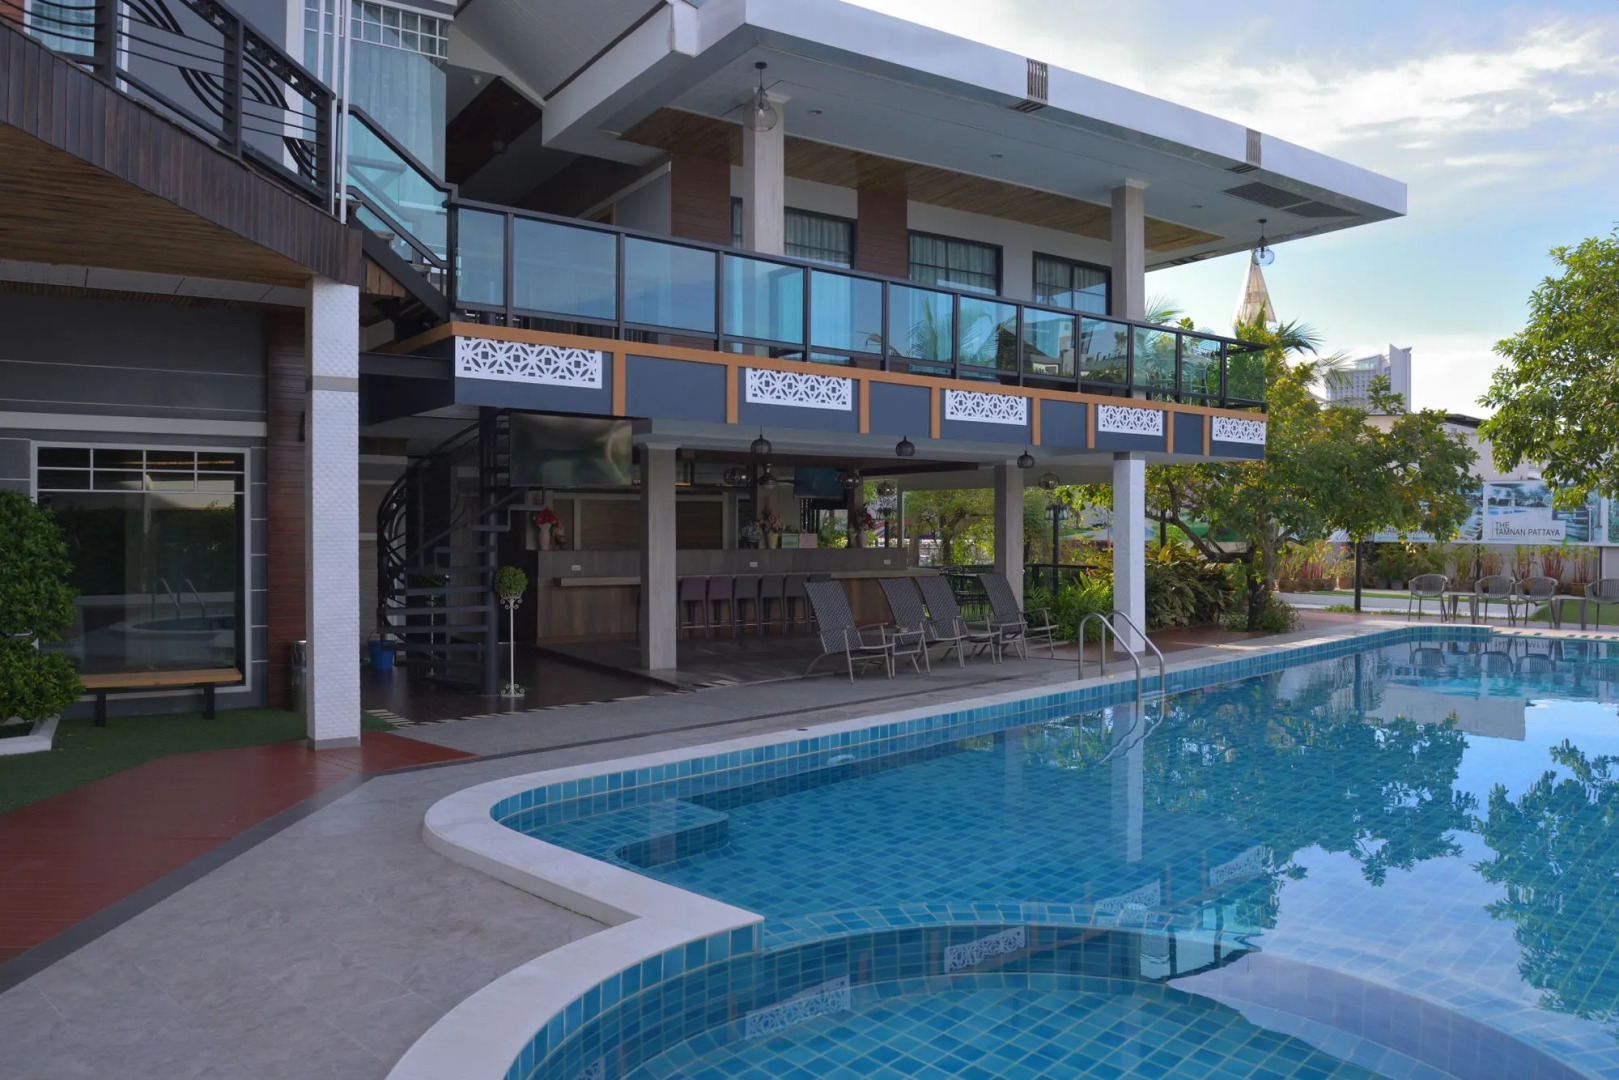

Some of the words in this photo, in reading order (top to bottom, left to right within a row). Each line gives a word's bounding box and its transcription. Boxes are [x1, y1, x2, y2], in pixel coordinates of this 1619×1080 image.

[1495, 521, 1510, 529] THE
[1495, 528, 1526, 536] TAMNAN
[1528, 528, 1560, 536] PATTAYA
